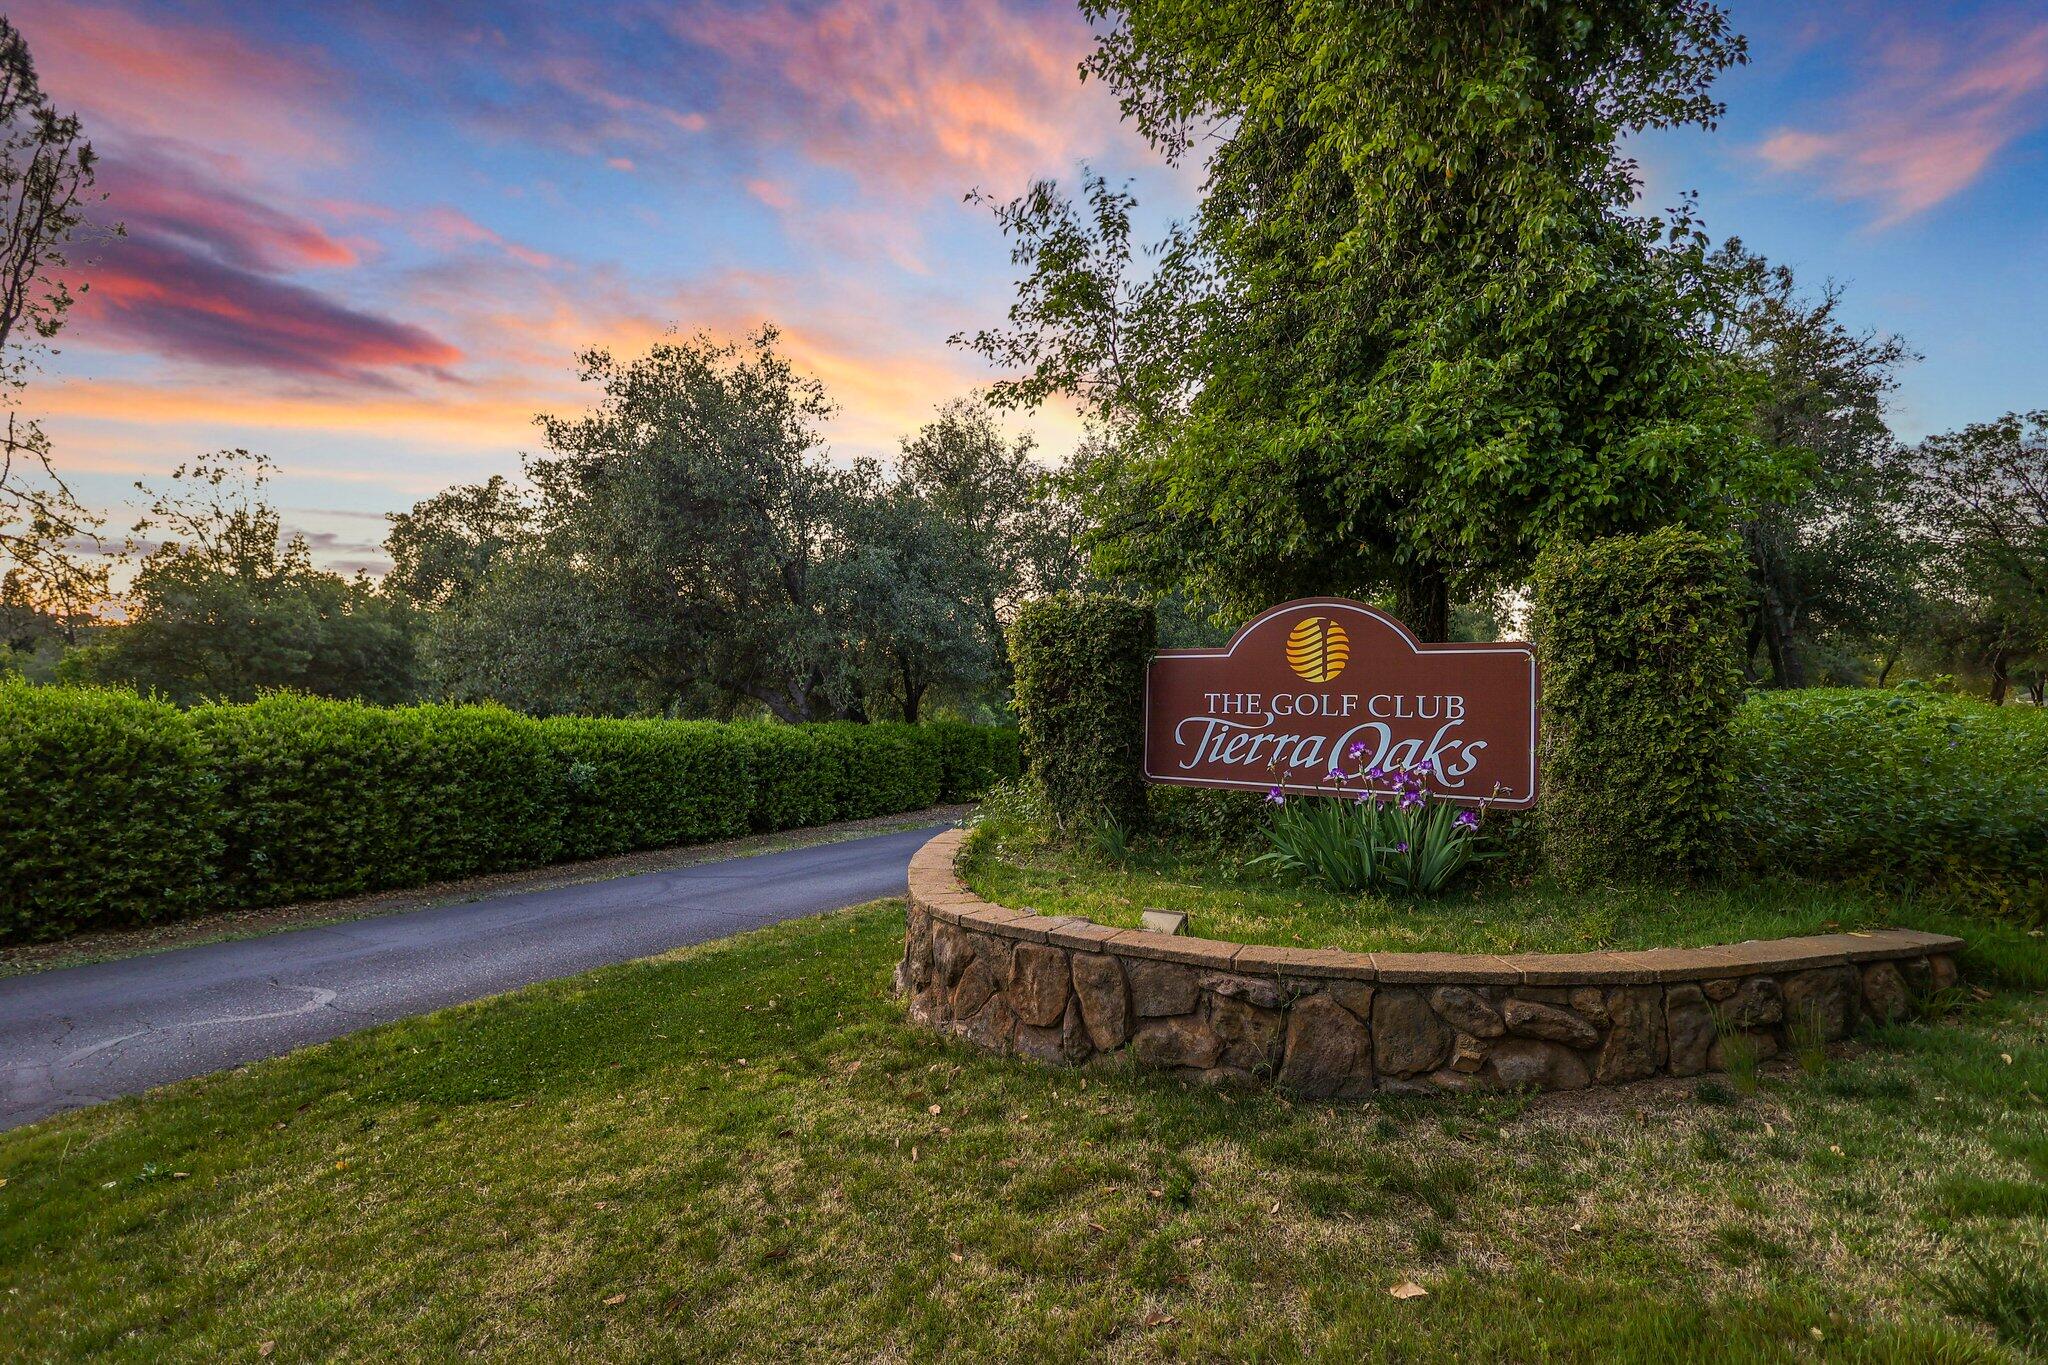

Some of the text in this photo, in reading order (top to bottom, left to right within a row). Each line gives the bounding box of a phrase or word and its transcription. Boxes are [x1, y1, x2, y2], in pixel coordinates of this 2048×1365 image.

[1204, 693, 1466, 719] THE GOLF CLUB
[1174, 711, 1488, 788] Tierra Oaks
